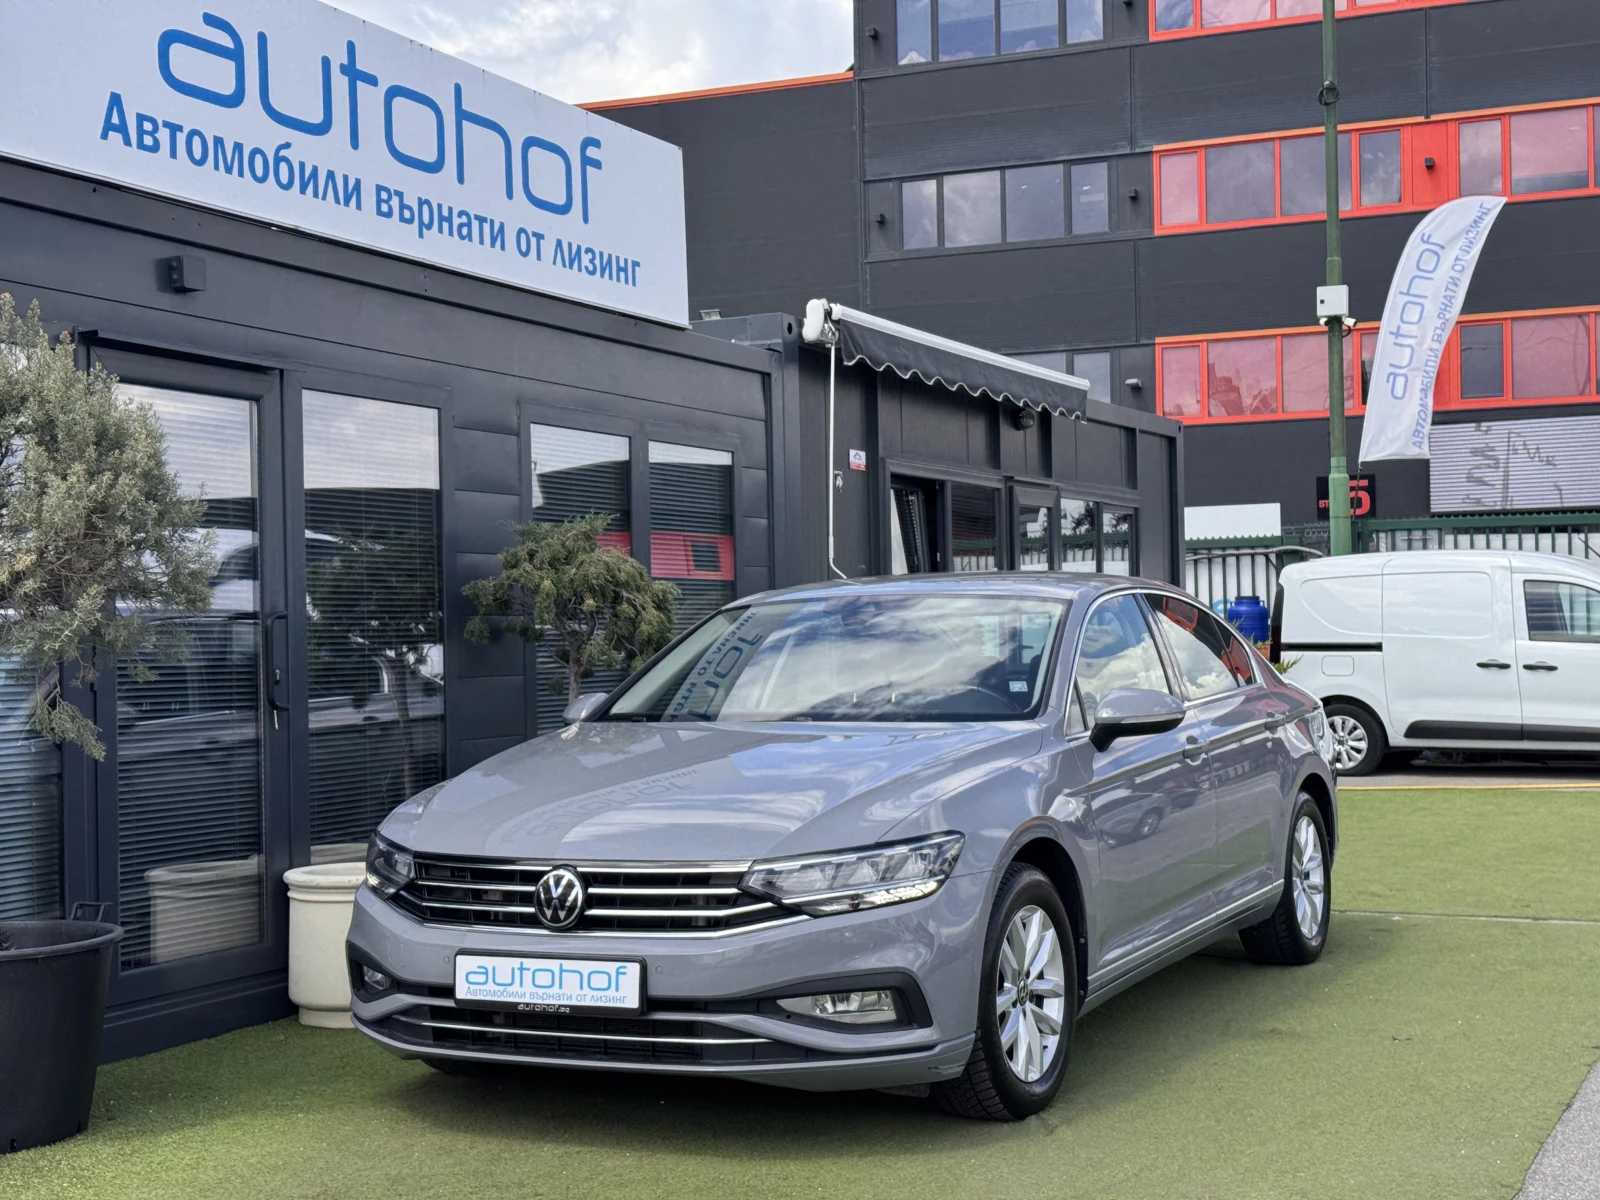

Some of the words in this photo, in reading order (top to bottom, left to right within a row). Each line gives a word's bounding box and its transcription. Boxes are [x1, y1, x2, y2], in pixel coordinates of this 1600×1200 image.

[157, 11, 603, 225] autohof
[100, 90, 362, 212] Автомобили
[374, 183, 506, 252] върнати
[515, 226, 546, 263] от
[552, 238, 641, 287] лизинг
[1451, 255, 1467, 273] ОТ
[1459, 202, 1491, 255] ЛИЗИНГ
[1385, 231, 1446, 400] autohof
[465, 961, 628, 992] autohof
[465, 985, 527, 1000] Автомобили
[529, 991, 573, 1003] върнати
[575, 994, 587, 1003] от
[589, 994, 628, 1004] лизинг
